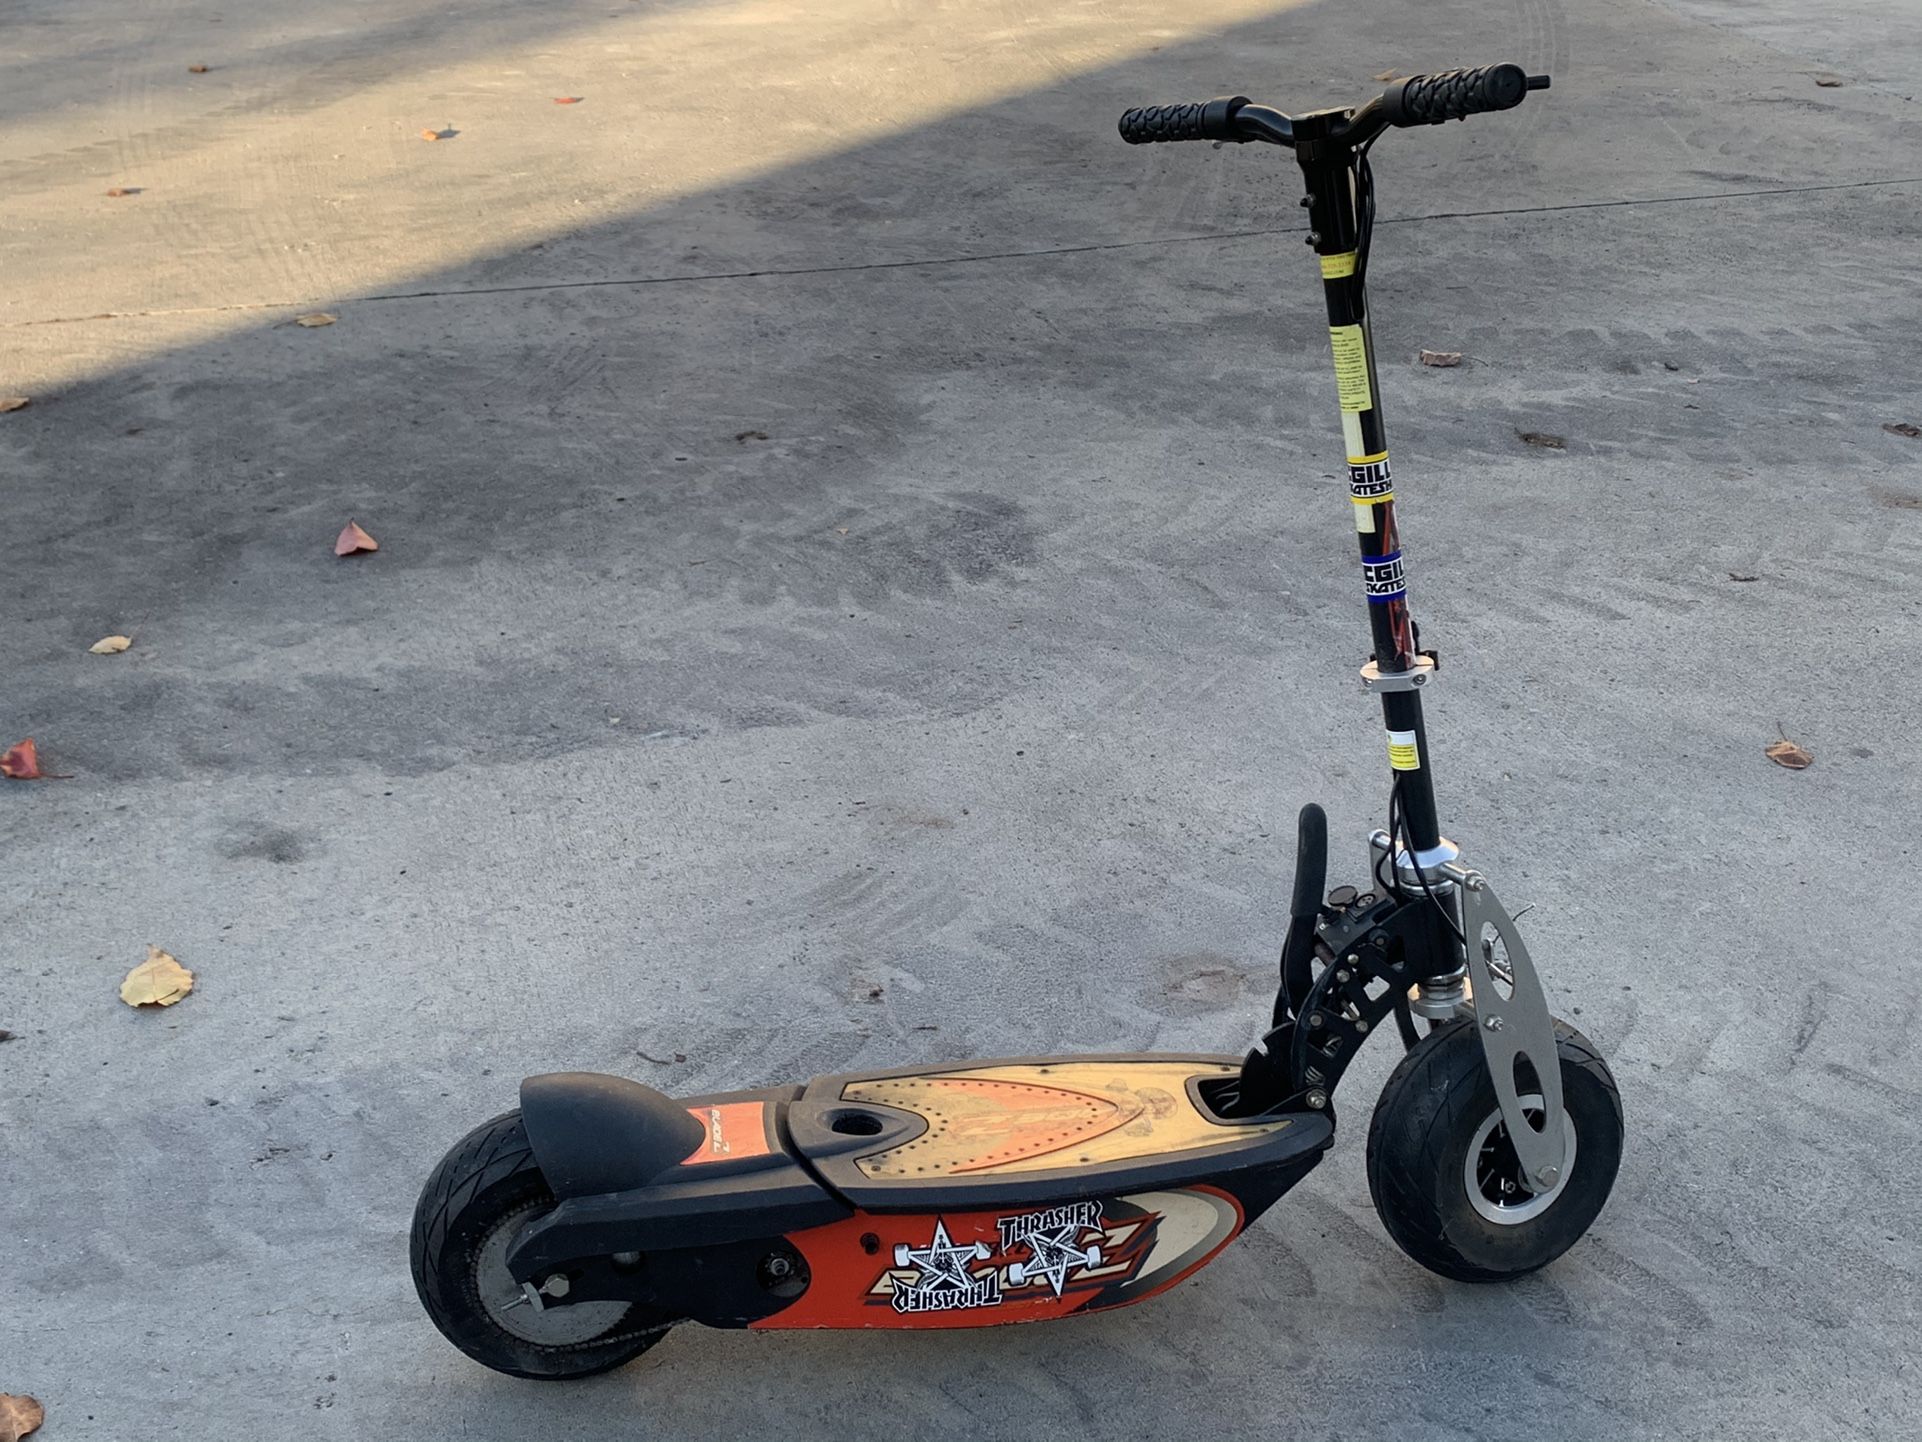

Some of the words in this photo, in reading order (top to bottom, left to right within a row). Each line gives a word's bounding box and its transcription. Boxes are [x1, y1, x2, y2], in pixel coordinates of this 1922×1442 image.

[1348, 461, 1390, 483] GILL
[997, 1199, 1104, 1250] THRASHER
[890, 1273, 1006, 1313] THRASHER
